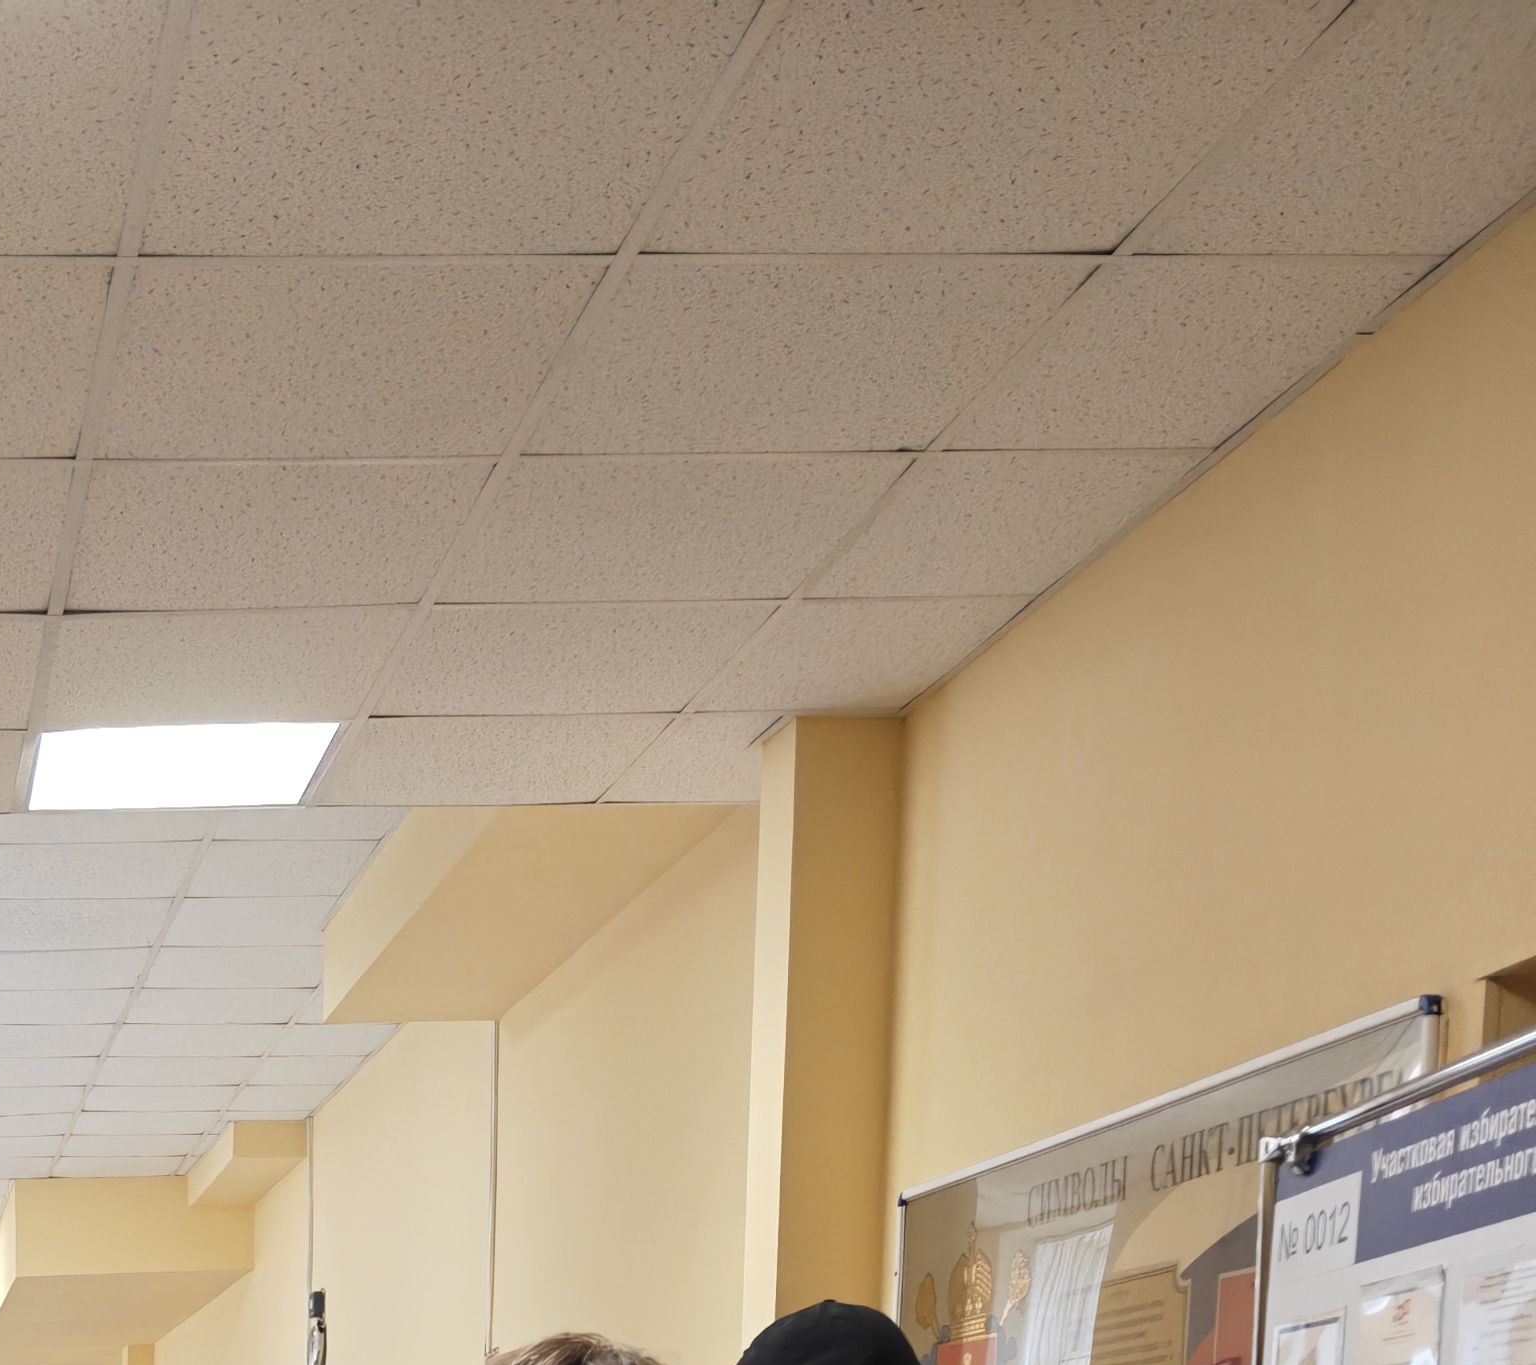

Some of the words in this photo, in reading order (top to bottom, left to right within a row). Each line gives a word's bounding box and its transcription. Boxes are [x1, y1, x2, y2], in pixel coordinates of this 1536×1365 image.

[1370, 1128, 1455, 1184] Участковая
[1026, 1155, 1128, 1228] СИМВОЛЫ
[1277, 1221, 1299, 1263] №
[1304, 1201, 1351, 1255] 0012
